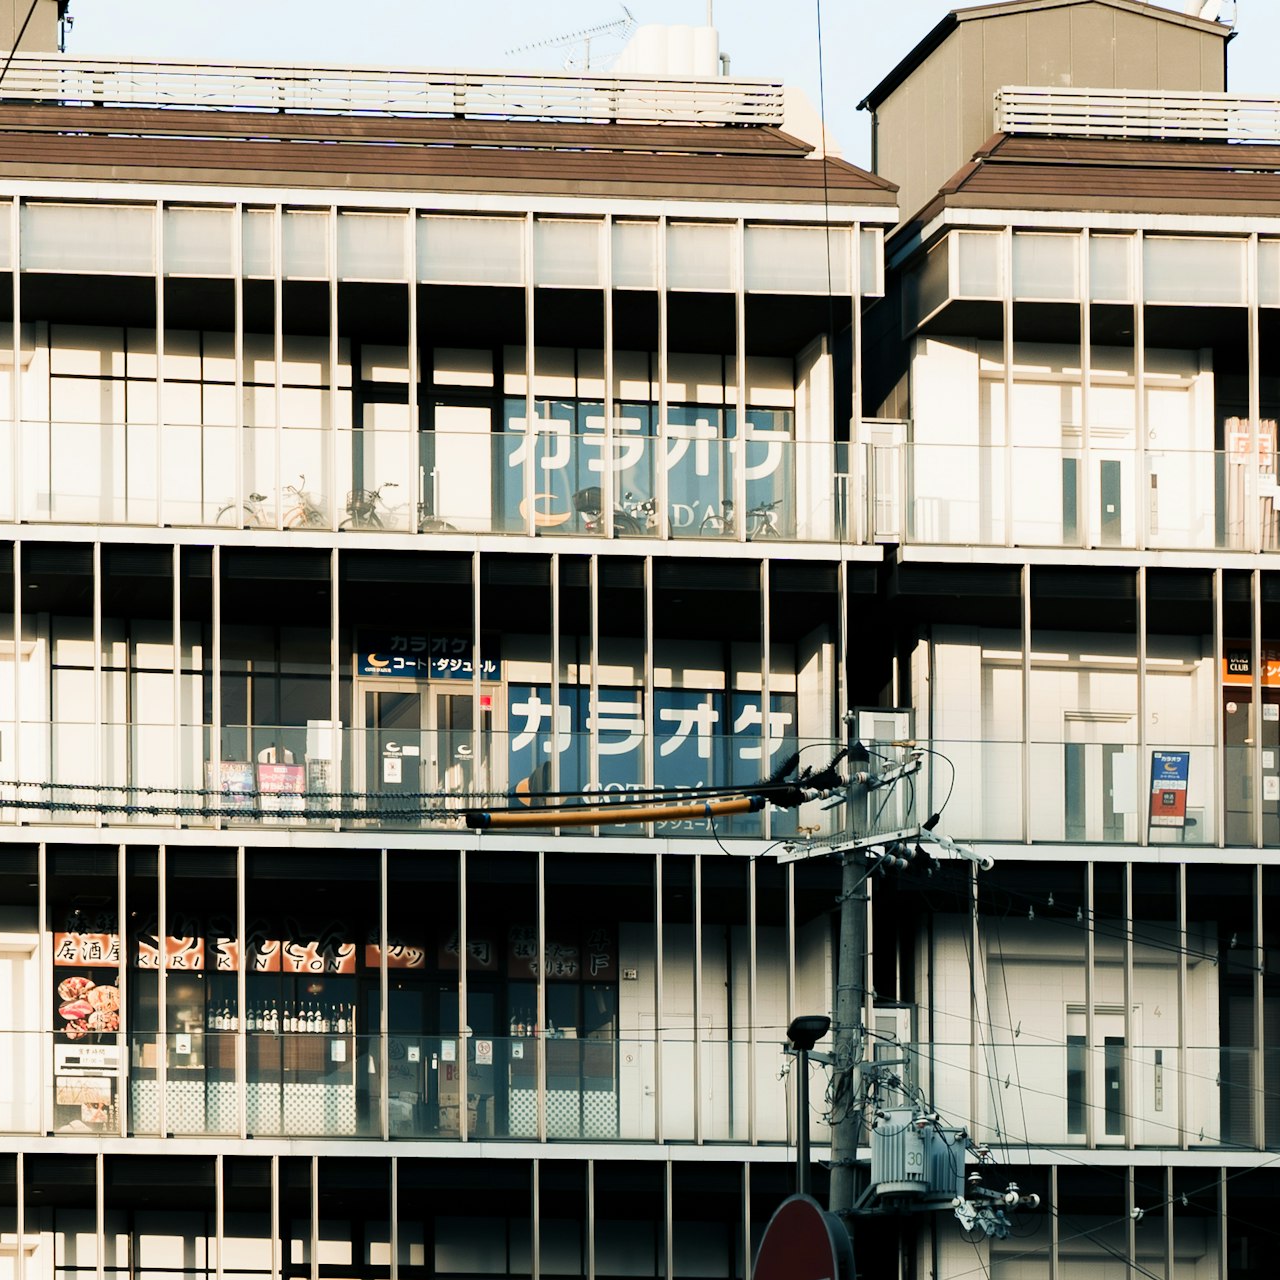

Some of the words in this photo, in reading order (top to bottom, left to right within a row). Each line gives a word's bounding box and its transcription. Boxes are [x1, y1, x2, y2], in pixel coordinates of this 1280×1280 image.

[508, 411, 790, 481] カラオケ
[1229, 663, 1249, 672] CLUB
[510, 694, 792, 759] カラオケ
[136, 955, 342, 972] KURIKNTON
